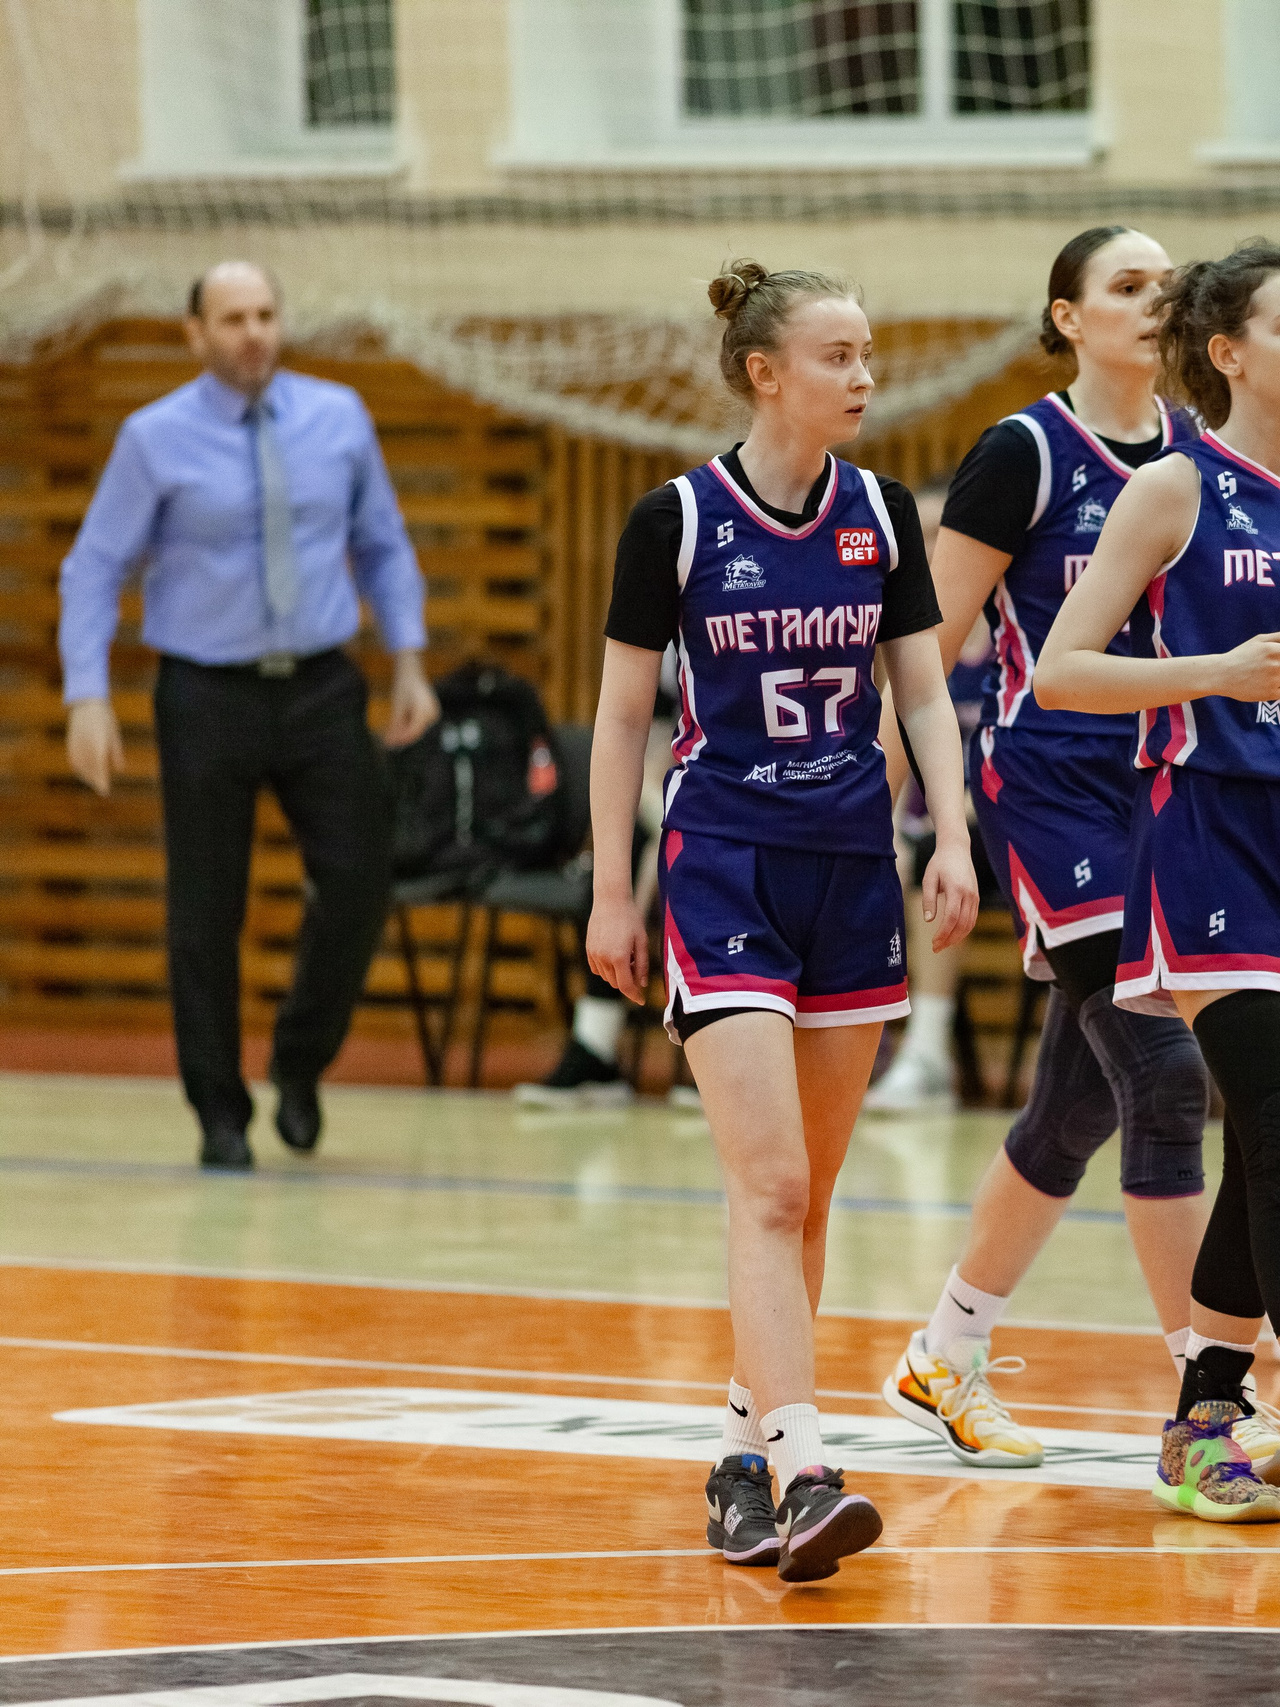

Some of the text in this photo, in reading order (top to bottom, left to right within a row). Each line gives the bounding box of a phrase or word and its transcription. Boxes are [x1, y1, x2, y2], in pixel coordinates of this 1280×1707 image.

[838, 532, 874, 547] FON
[841, 546, 875, 561] BET
[760, 666, 861, 742] 67
